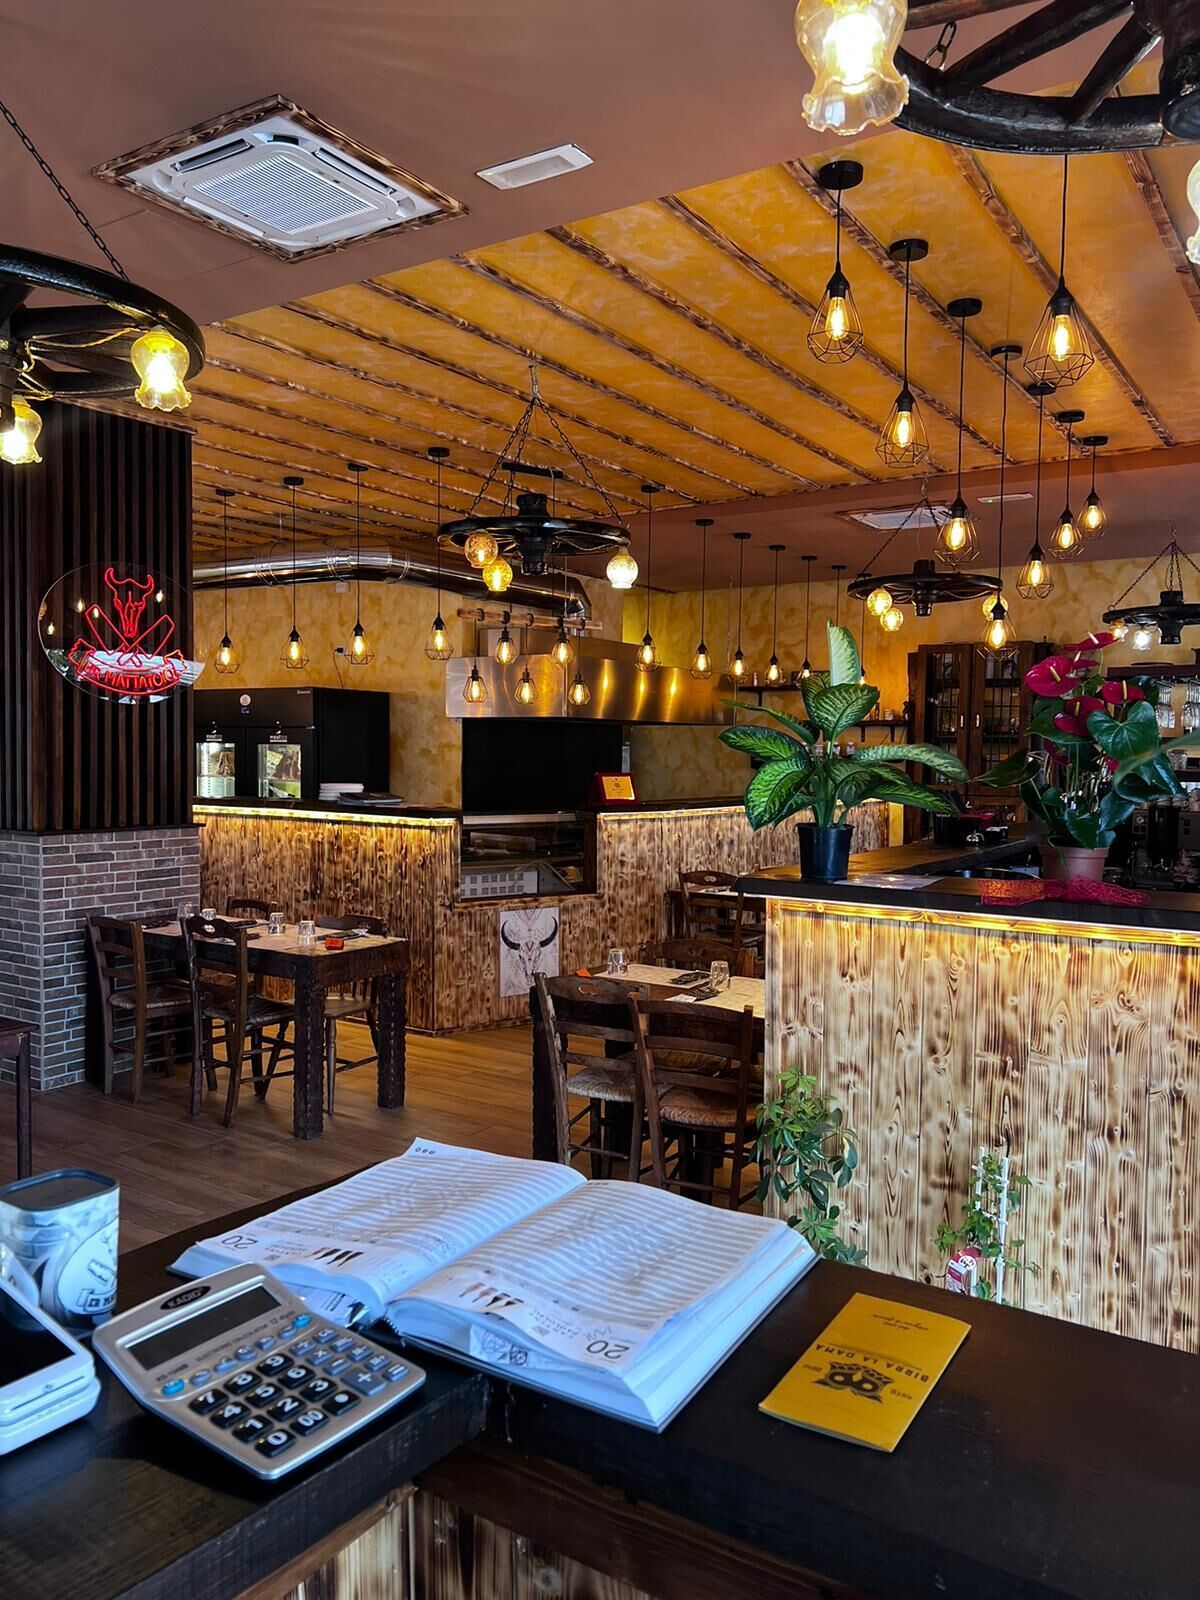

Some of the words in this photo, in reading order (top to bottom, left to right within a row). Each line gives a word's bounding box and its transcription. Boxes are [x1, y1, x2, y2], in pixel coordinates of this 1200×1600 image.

[104, 669, 175, 689] MATTATOIO
[221, 1235, 258, 1250] 20
[167, 1289, 202, 1309] KADIO
[586, 1340, 630, 1360] 20
[816, 1343, 855, 1359] DAMA
[264, 1354, 285, 1367] 9
[863, 1356, 883, 1368] LA
[234, 1373, 254, 1385] 8
[287, 1367, 307, 1379] 6
[886, 1362, 929, 1383] BIRRA
[255, 1385, 276, 1398] 5
[309, 1379, 329, 1392] 3
[202, 1391, 215, 1404] 7
[277, 1397, 299, 1412] 2
[223, 1404, 242, 1418] 4
[245, 1418, 263, 1429] 1
[297, 1410, 324, 1427] 00
[266, 1431, 288, 1446] 0
